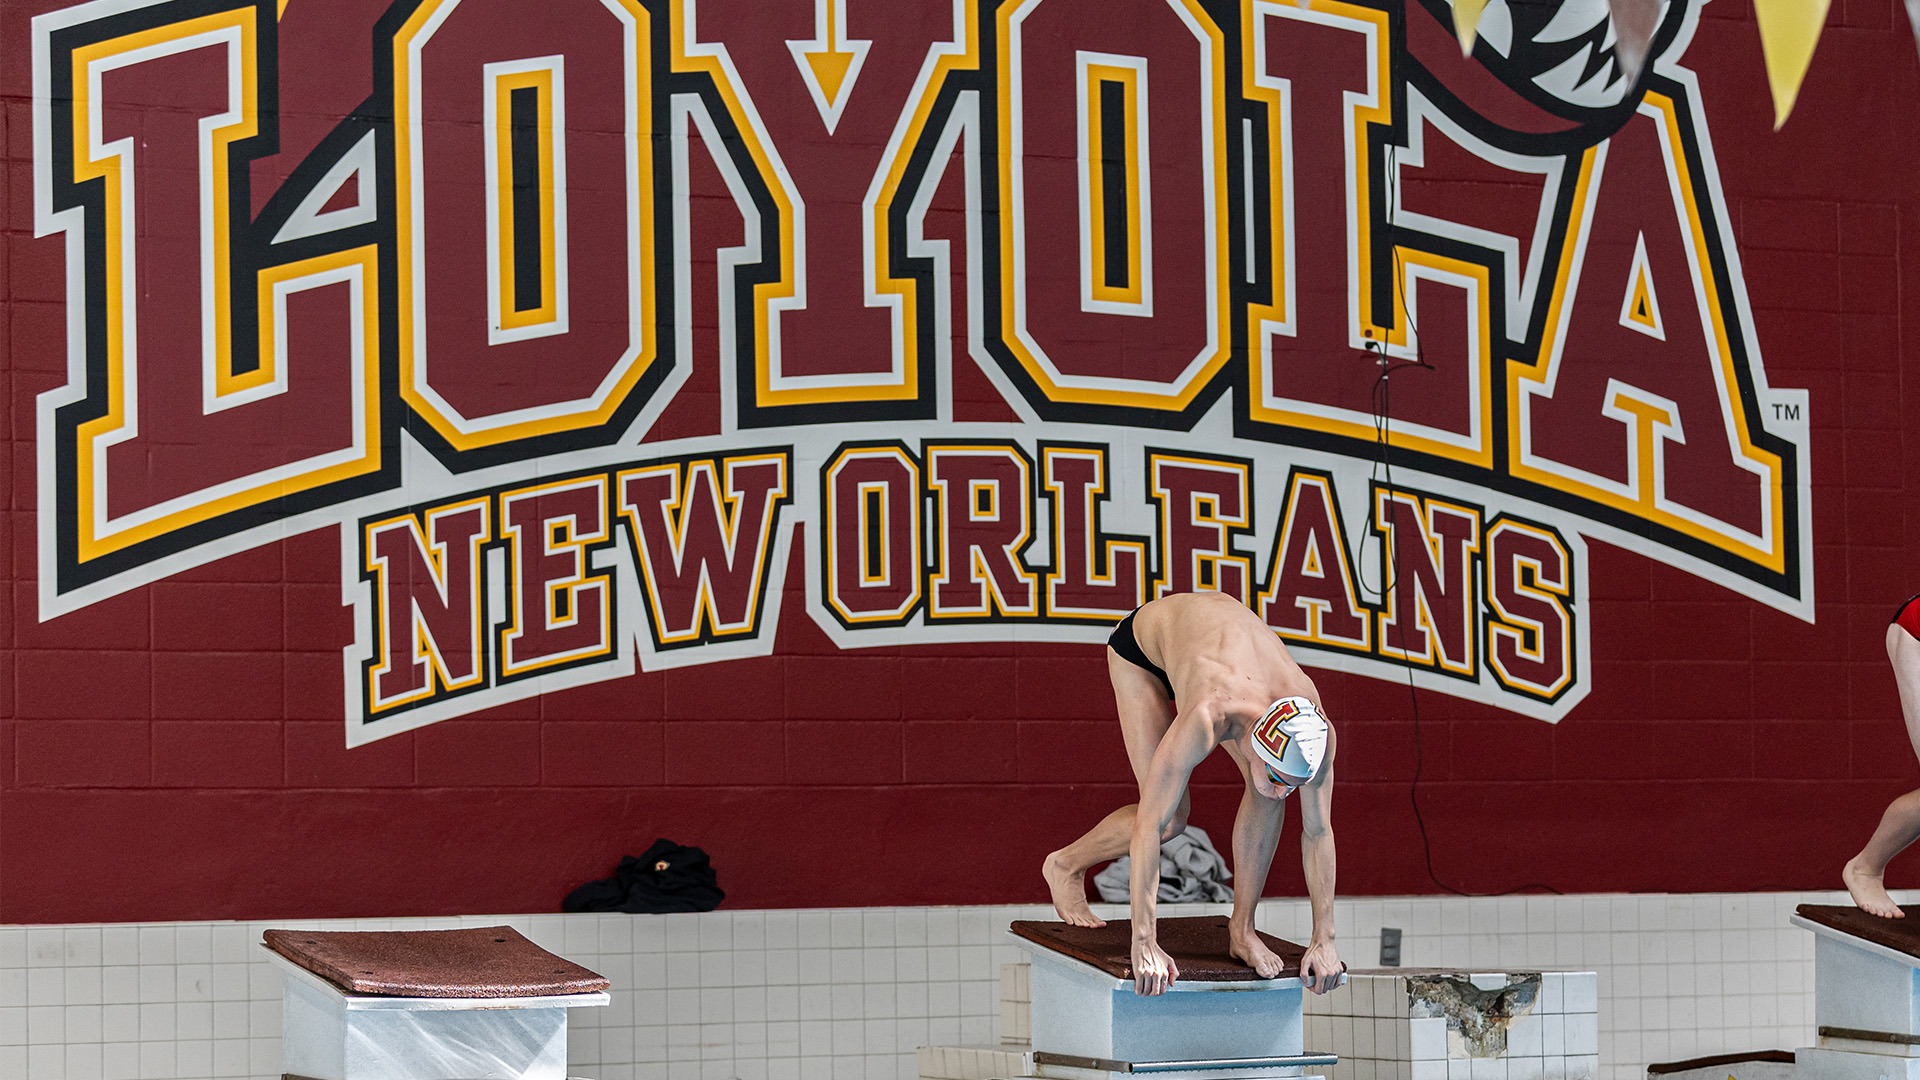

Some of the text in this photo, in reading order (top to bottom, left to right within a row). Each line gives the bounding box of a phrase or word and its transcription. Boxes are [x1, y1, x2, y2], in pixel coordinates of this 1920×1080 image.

[72, 0, 1788, 578] LOYOLA
[1772, 403, 1800, 420] TM
[364, 440, 1574, 716] NEW ORLEANS
[1253, 699, 1301, 763] L
